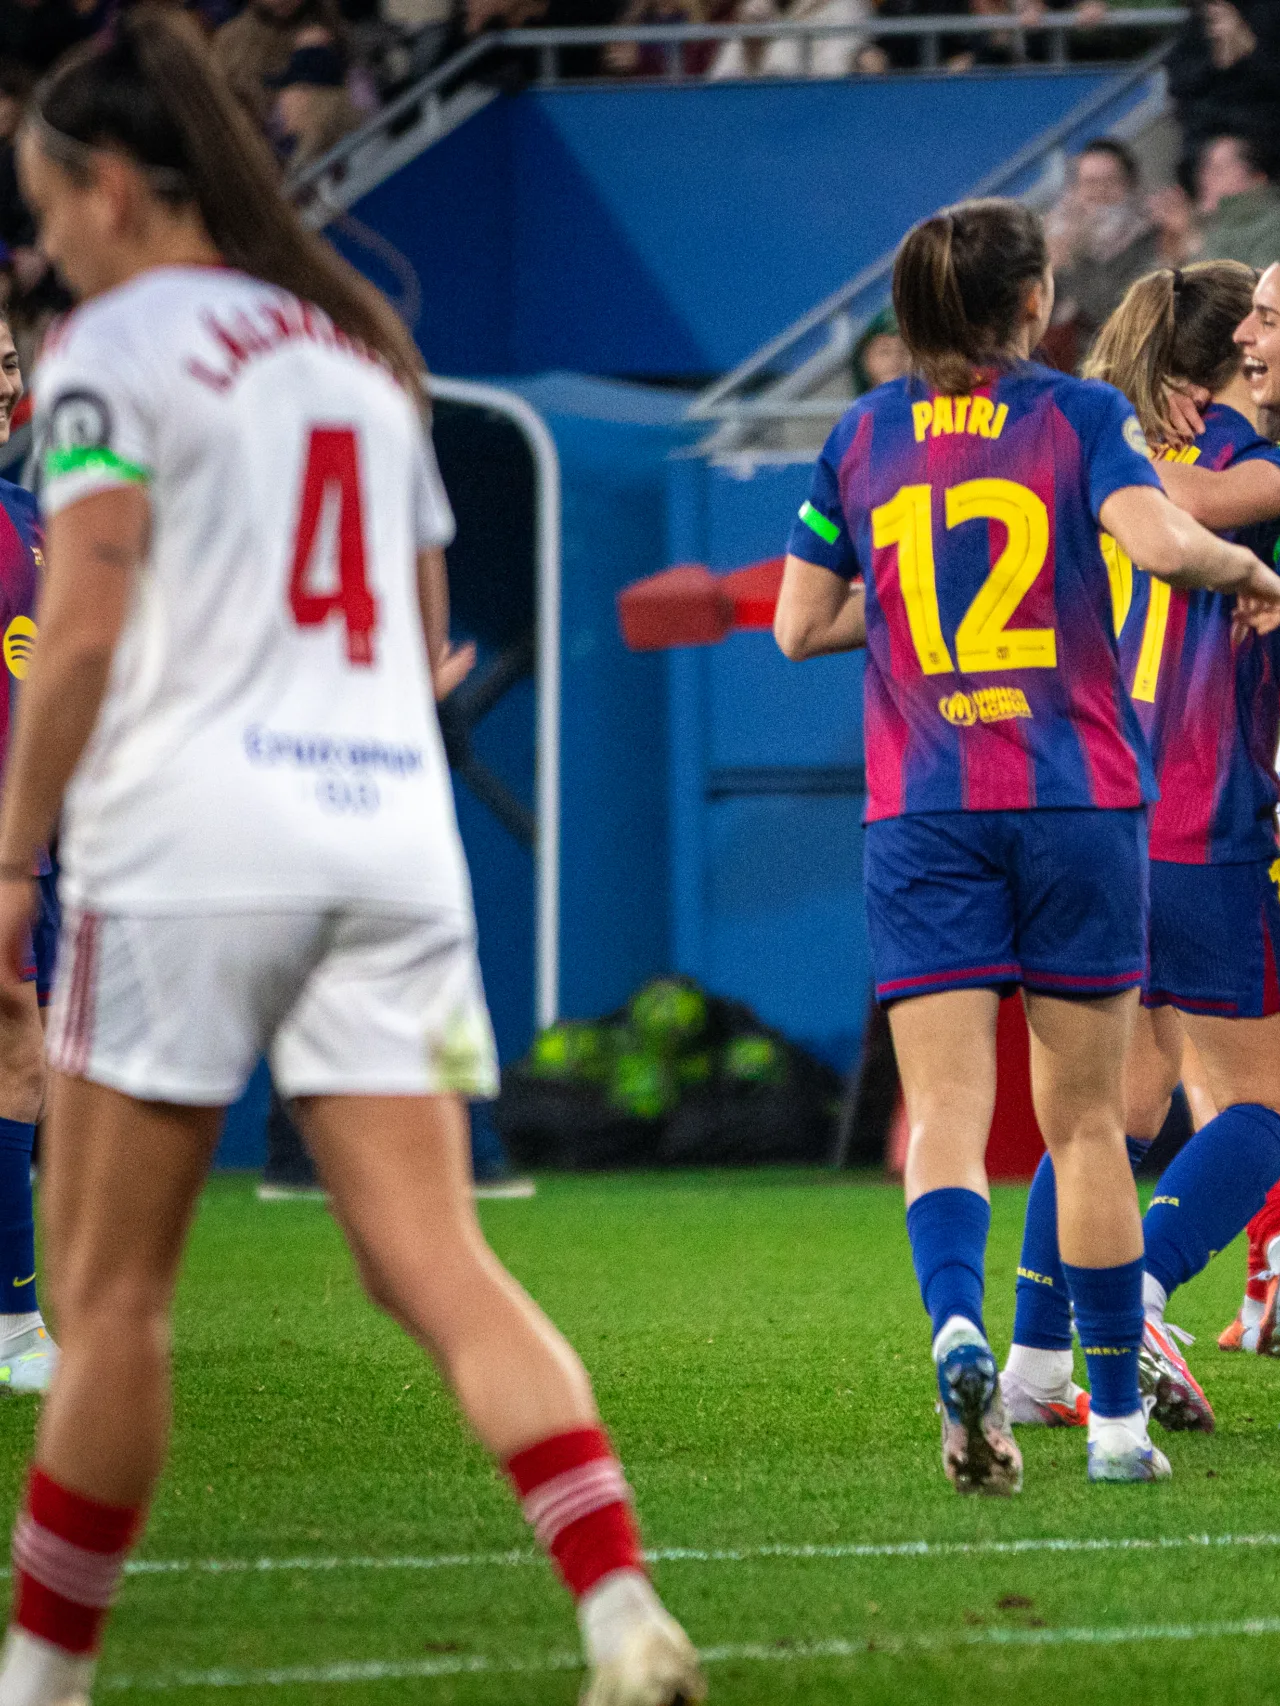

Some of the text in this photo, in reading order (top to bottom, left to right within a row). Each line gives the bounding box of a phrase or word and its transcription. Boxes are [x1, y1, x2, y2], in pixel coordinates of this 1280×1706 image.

[912, 396, 1008, 442] PATRI
[289, 427, 375, 664] 4
[871, 477, 1057, 675] 12
